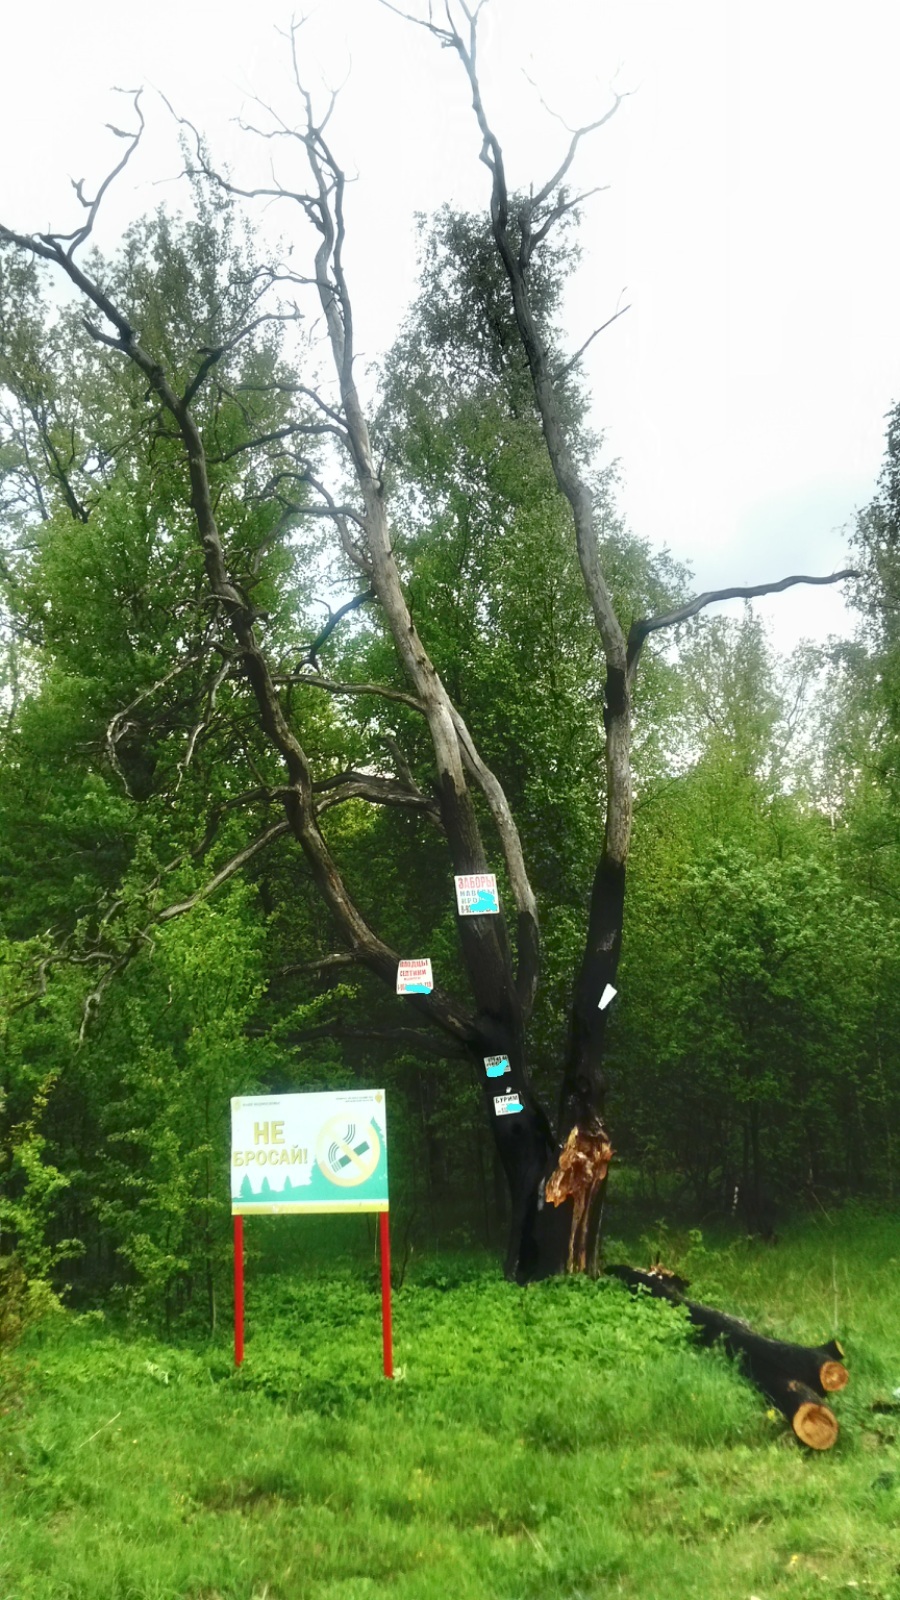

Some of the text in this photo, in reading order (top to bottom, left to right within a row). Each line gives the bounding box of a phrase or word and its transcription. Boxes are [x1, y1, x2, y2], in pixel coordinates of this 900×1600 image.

[458, 876, 495, 889] ЗАБОРЫ
[253, 1121, 285, 1145] НЕ
[232, 1145, 308, 1167] БРОСАЙ!
